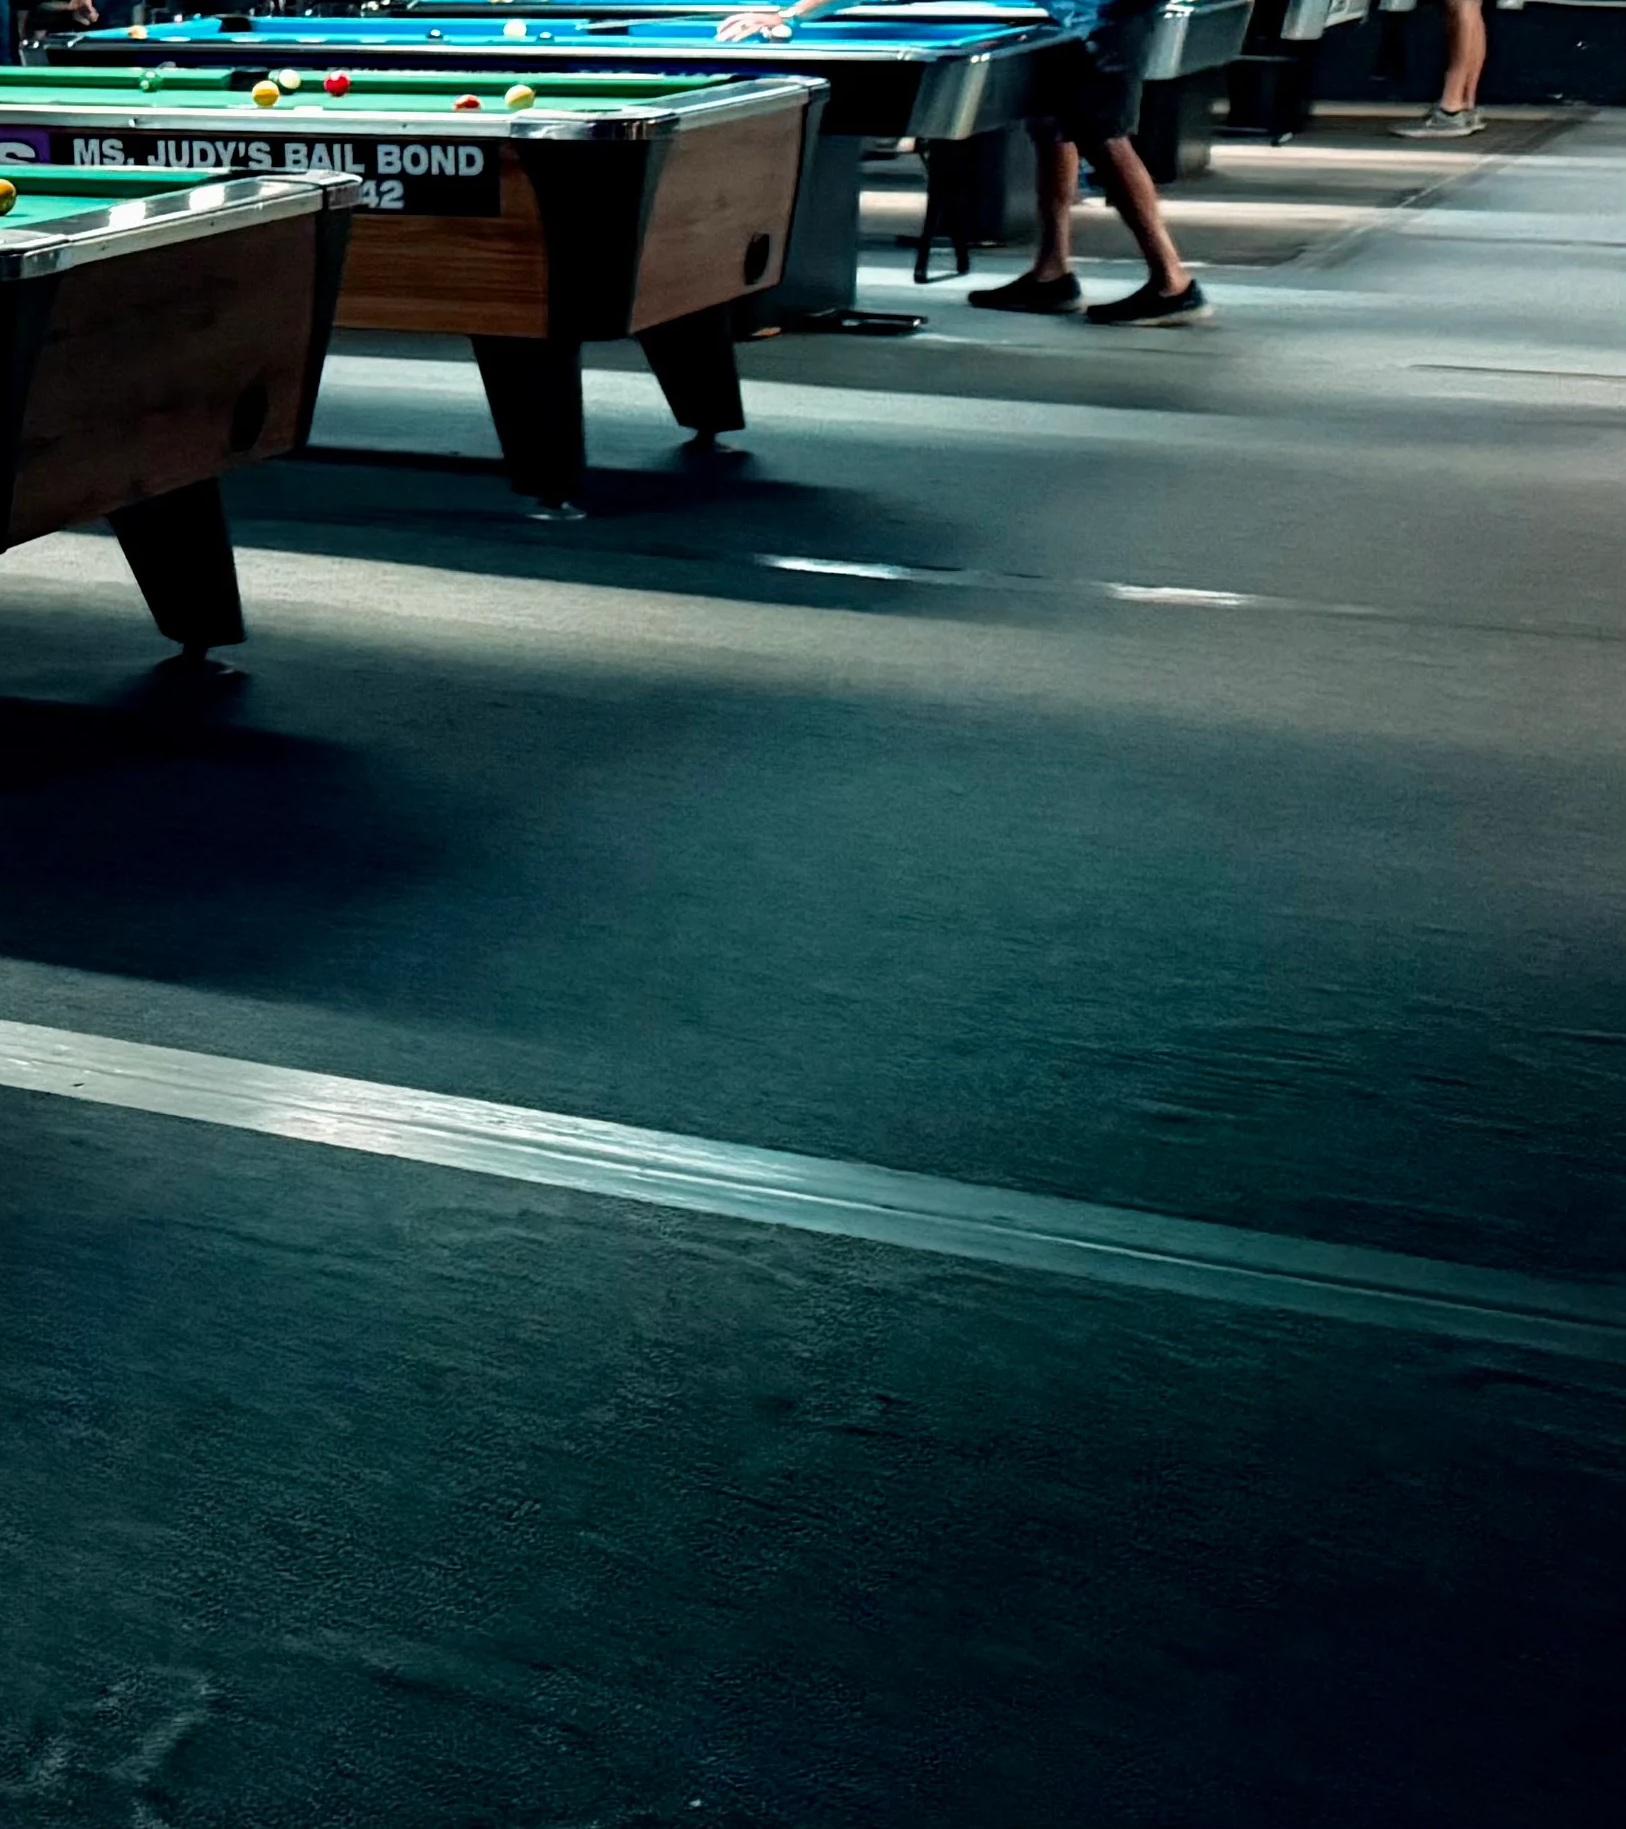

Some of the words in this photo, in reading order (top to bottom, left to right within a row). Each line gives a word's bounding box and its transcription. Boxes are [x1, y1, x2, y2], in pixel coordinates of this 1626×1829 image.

[72, 138, 135, 167] MS.
[148, 139, 273, 170] JUDY'S
[283, 141, 365, 174] BAIL
[376, 144, 485, 177] BOND
